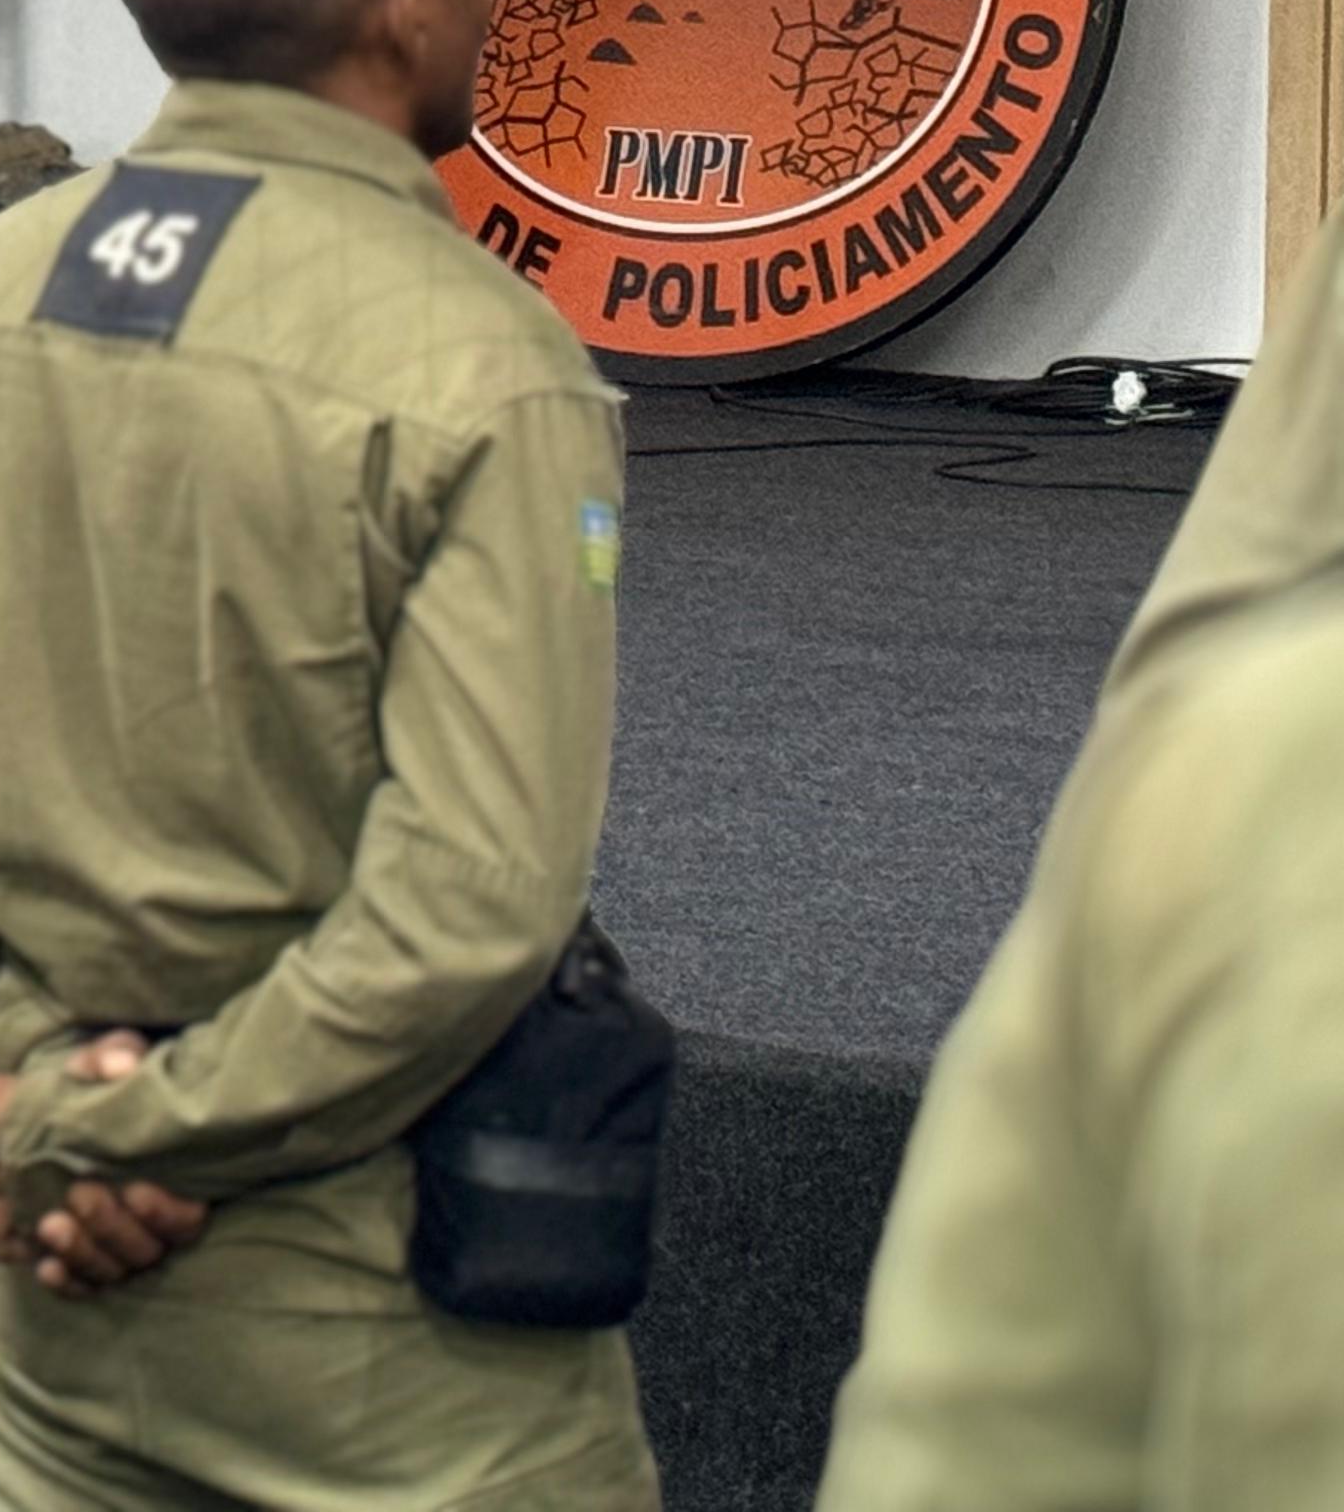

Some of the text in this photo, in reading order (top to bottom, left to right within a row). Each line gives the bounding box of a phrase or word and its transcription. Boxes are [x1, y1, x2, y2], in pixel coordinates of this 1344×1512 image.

[476, 202, 561, 287] DE
[602, 13, 1065, 328] POLICIAMENTO
[597, 126, 752, 206] PMPI
[86, 206, 201, 287] 45
